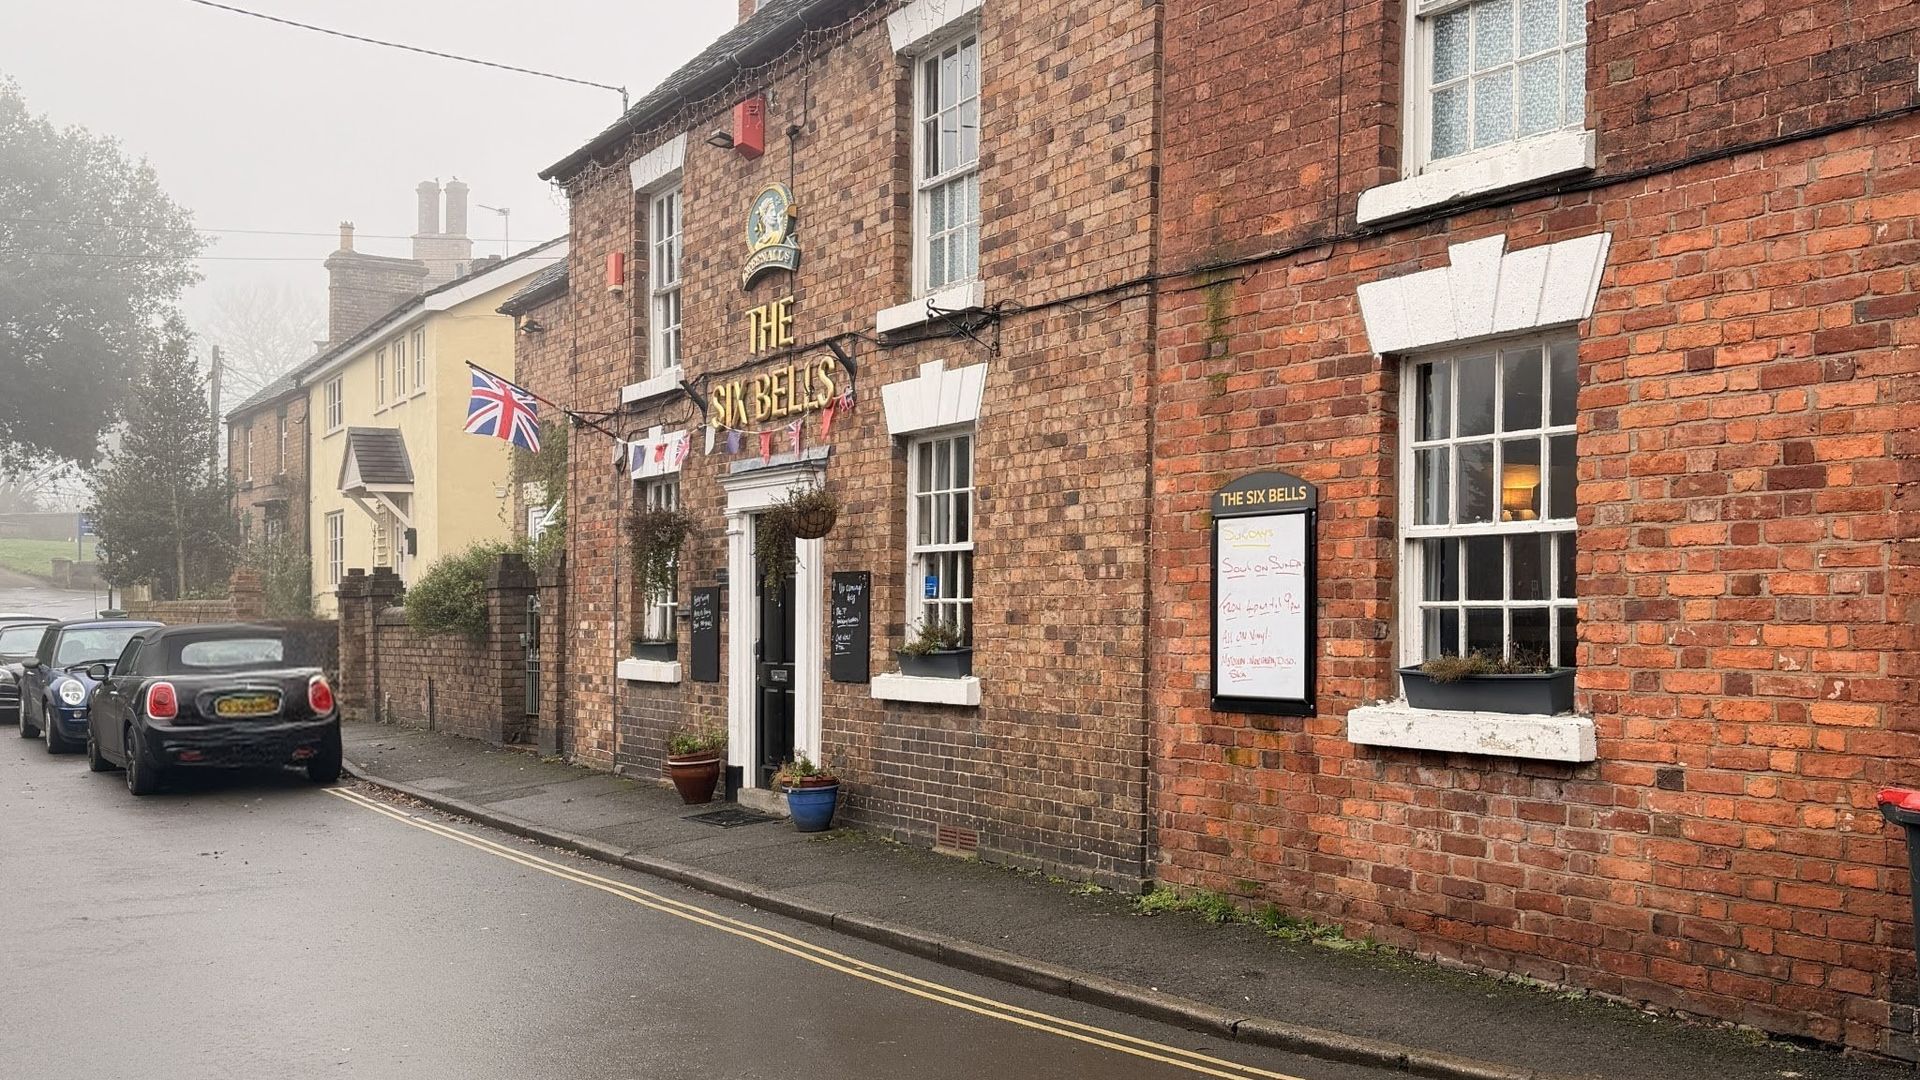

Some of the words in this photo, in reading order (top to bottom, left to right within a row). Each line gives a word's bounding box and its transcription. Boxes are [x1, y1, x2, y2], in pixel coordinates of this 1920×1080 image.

[745, 296, 793, 354] THE
[711, 379, 748, 428] SIX
[755, 355, 836, 423] BELLS
[1220, 491, 1244, 507] THE
[1246, 489, 1266, 505] SIX
[1268, 485, 1307, 503] BELLS
